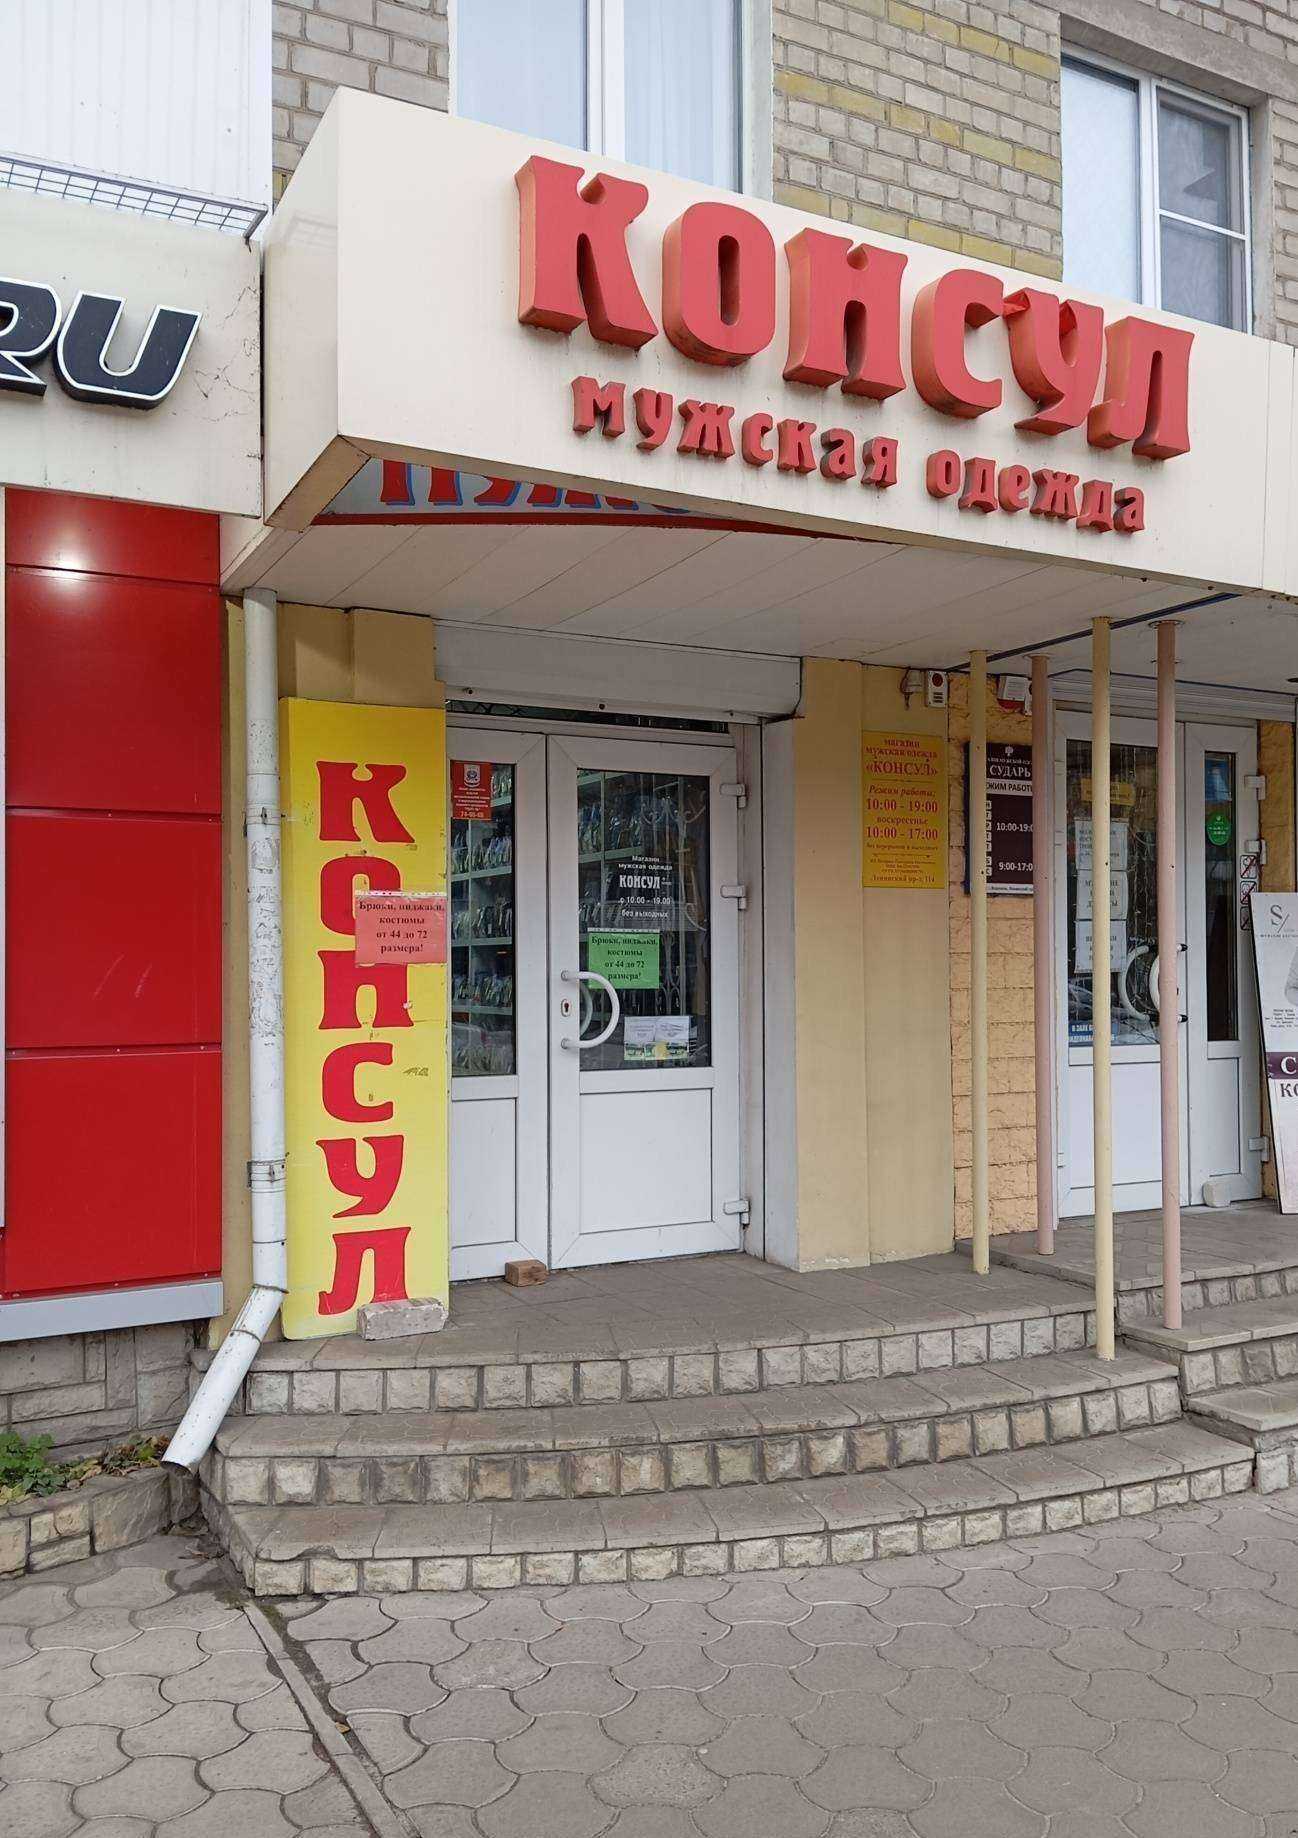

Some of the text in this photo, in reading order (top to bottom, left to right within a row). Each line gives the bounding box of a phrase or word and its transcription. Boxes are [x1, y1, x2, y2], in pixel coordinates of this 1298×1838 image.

[515, 155, 1195, 461] КОНСУЛ
[926, 450, 1146, 534] одежда
[989, 764, 1031, 778] СУДАРЬ
[1008, 783, 1033, 793] РАБОТ
[867, 798, 897, 810] 10:00
[909, 800, 938, 813] 19:00
[867, 826, 897, 838] 10:00
[909, 828, 938, 841] 17:00
[619, 874, 661, 889] КОНСУЛ
[379, 916, 425, 924] костюмы
[390, 930, 400, 938] 44
[402, 932, 415, 940] до
[417, 930, 428, 938] 72
[380, 943, 424, 954] размера!
